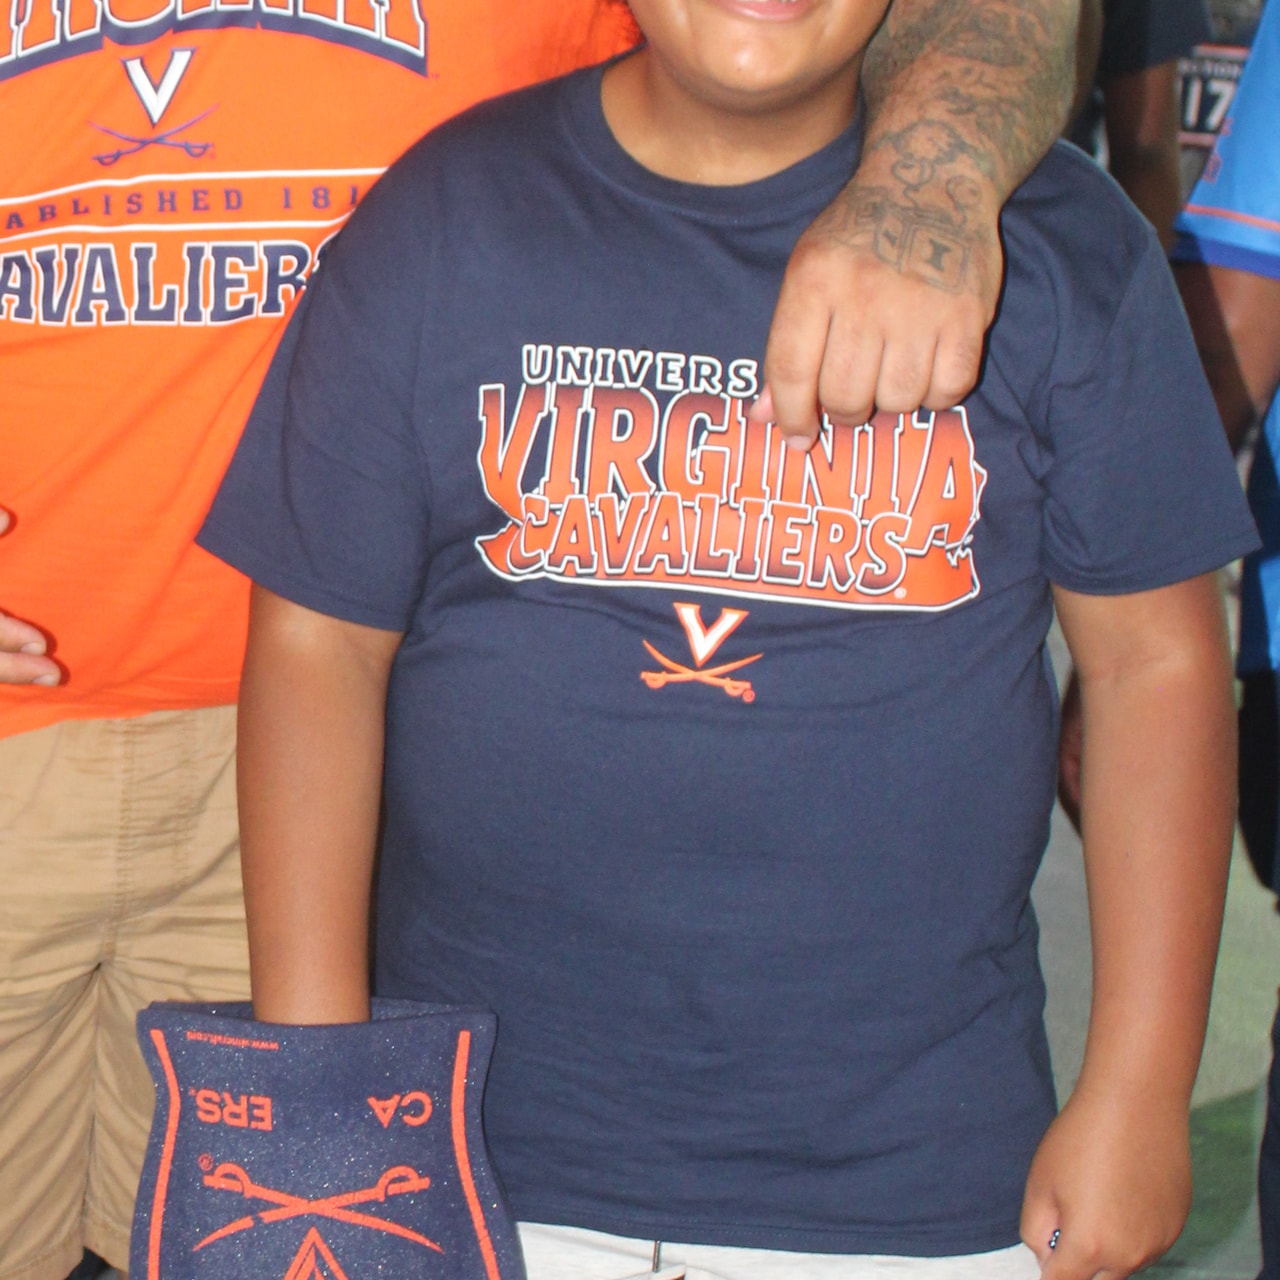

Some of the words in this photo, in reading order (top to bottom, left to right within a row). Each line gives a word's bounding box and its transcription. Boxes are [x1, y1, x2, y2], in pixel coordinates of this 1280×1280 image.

[283, 184, 358, 209] 181
[522, 344, 759, 400] UNIVERS
[477, 383, 982, 552] VIRGINIA
[506, 492, 913, 596] CAVALIERS
[195, 1088, 273, 1131] ERS
[367, 1090, 433, 1129] CA
